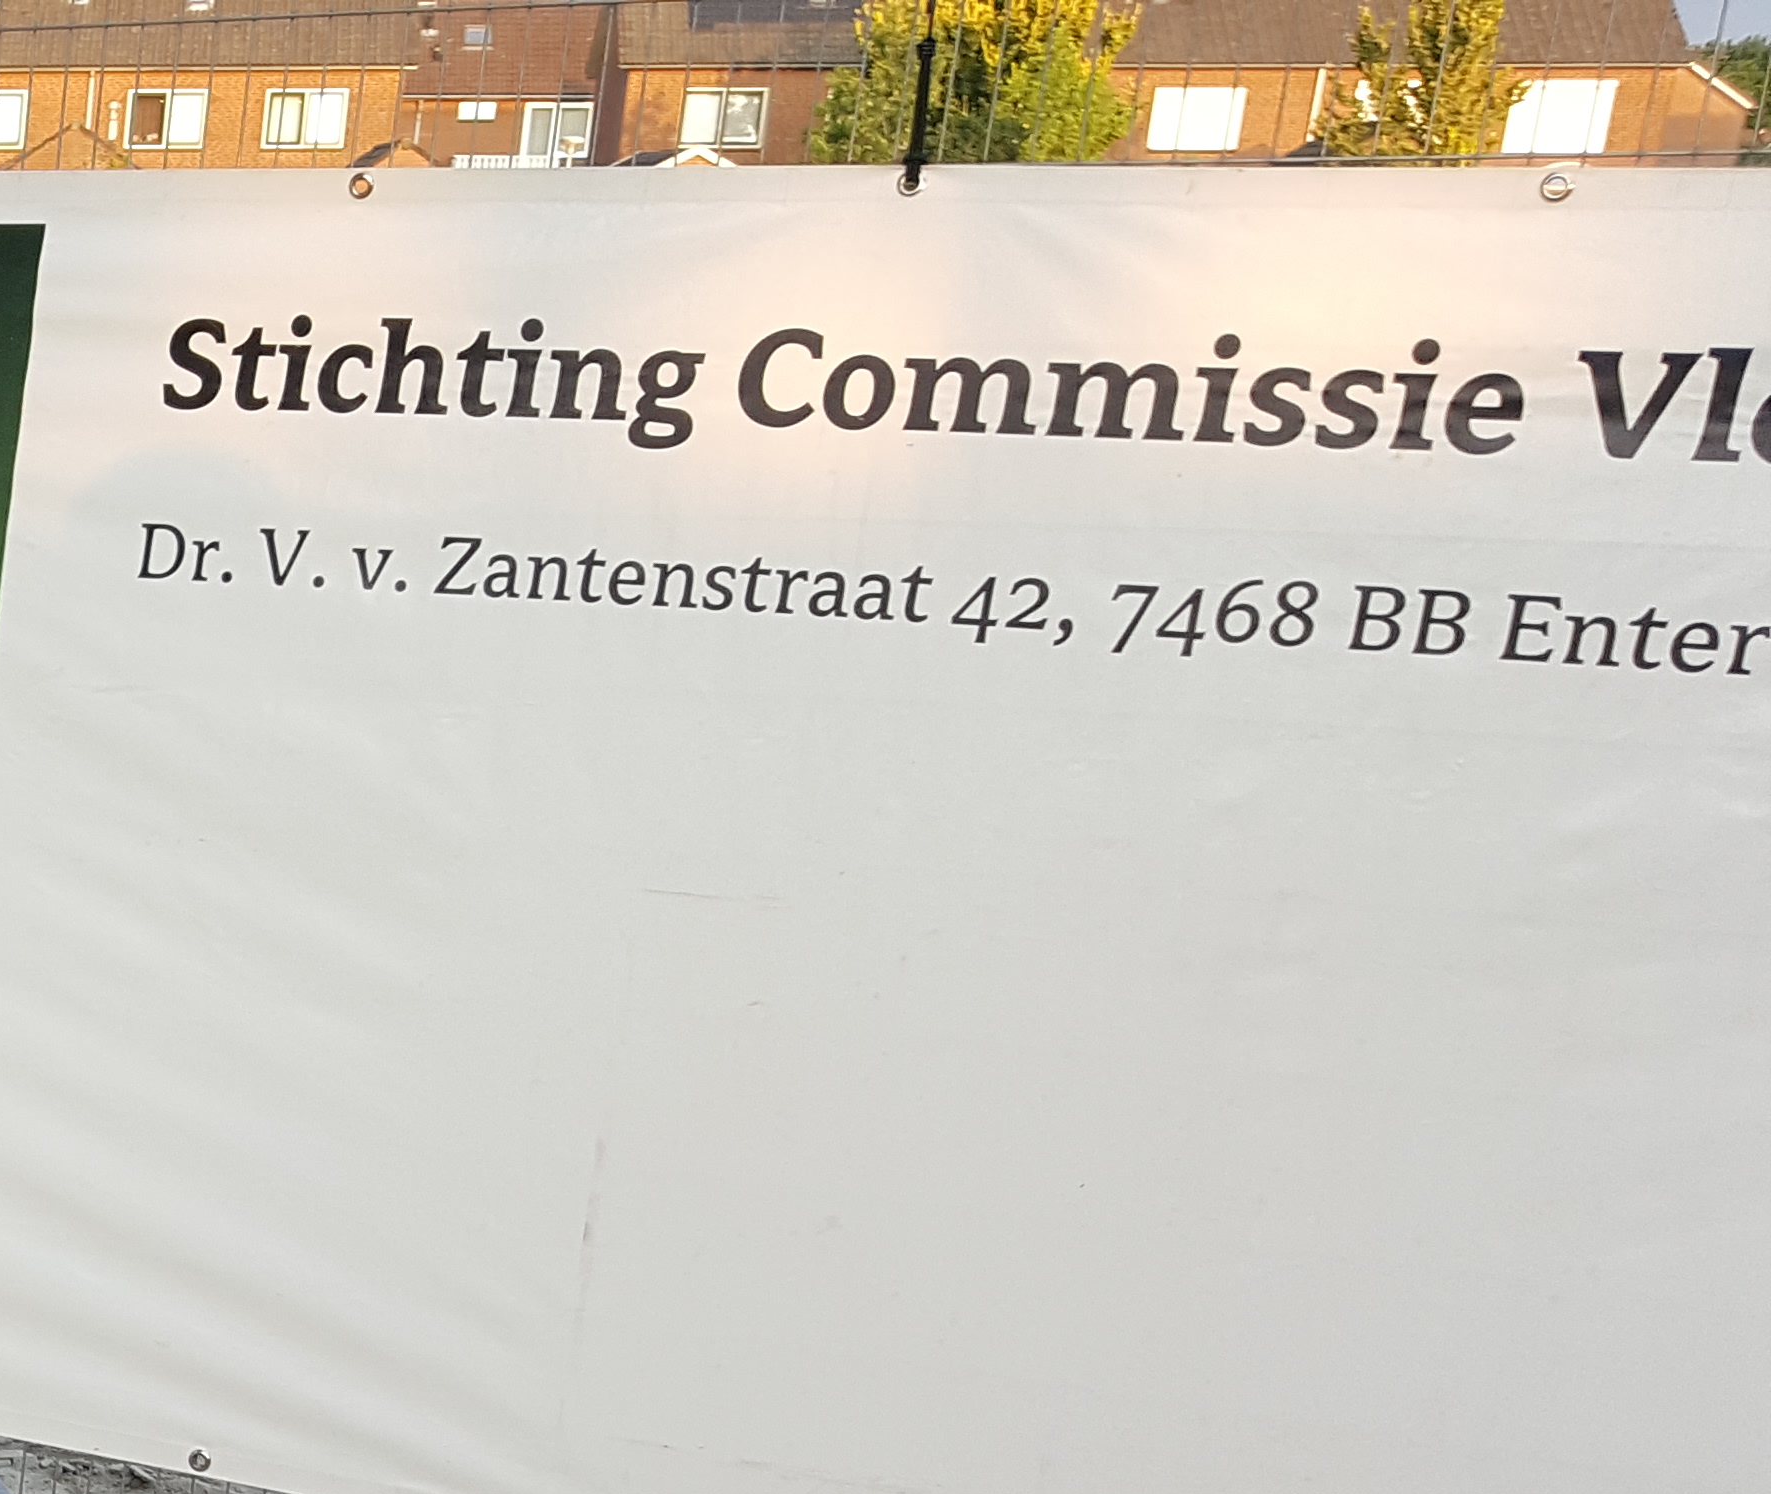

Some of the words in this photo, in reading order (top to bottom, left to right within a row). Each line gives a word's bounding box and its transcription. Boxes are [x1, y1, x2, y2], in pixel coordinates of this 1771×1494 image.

[163, 314, 706, 450] Stichting
[738, 328, 1524, 455] Commissie
[1577, 347, 1771, 464] Vl
[138, 523, 235, 583] Dr.
[260, 527, 327, 587] V.
[352, 547, 409, 591] v.
[434, 536, 933, 623] Zantenstraat
[951, 576, 1074, 646] 42,
[1111, 579, 1320, 657] 7468
[1348, 584, 1472, 655] BB
[1499, 593, 1771, 676] Enter
